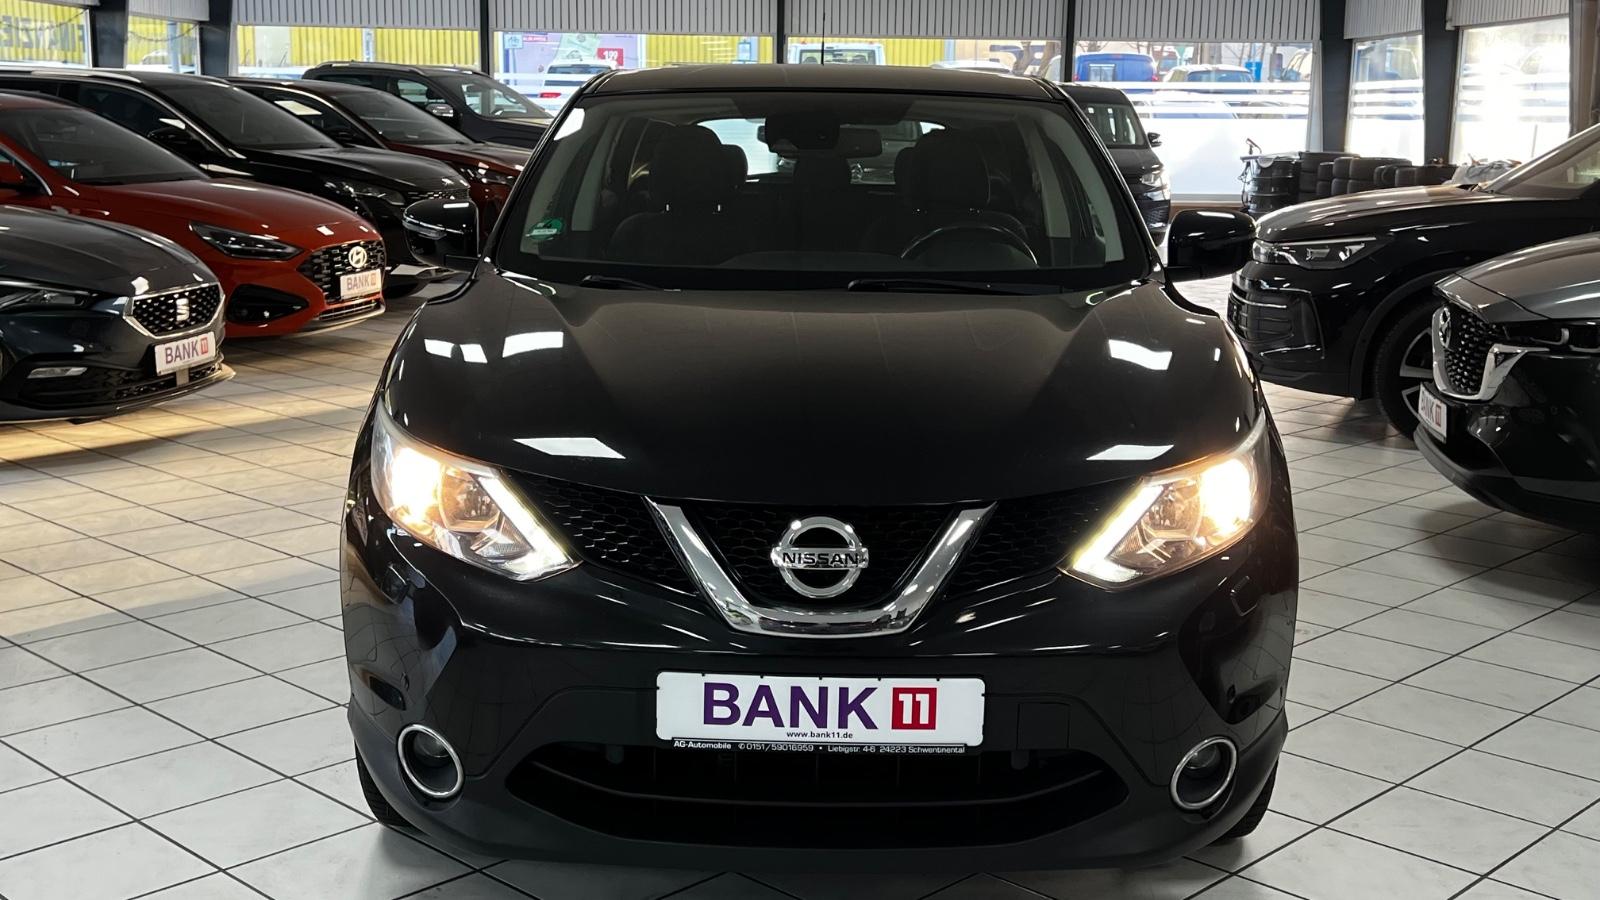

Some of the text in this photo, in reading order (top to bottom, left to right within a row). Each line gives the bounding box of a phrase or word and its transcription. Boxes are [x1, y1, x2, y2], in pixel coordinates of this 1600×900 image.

[165, 340, 199, 364] BANK
[782, 552, 859, 565] NISSAN
[703, 682, 933, 730] BANK 11
[786, 731, 854, 739] www.bank11.de
[673, 740, 732, 750] AG-Automobile
[908, 746, 966, 754] Schwentinental
